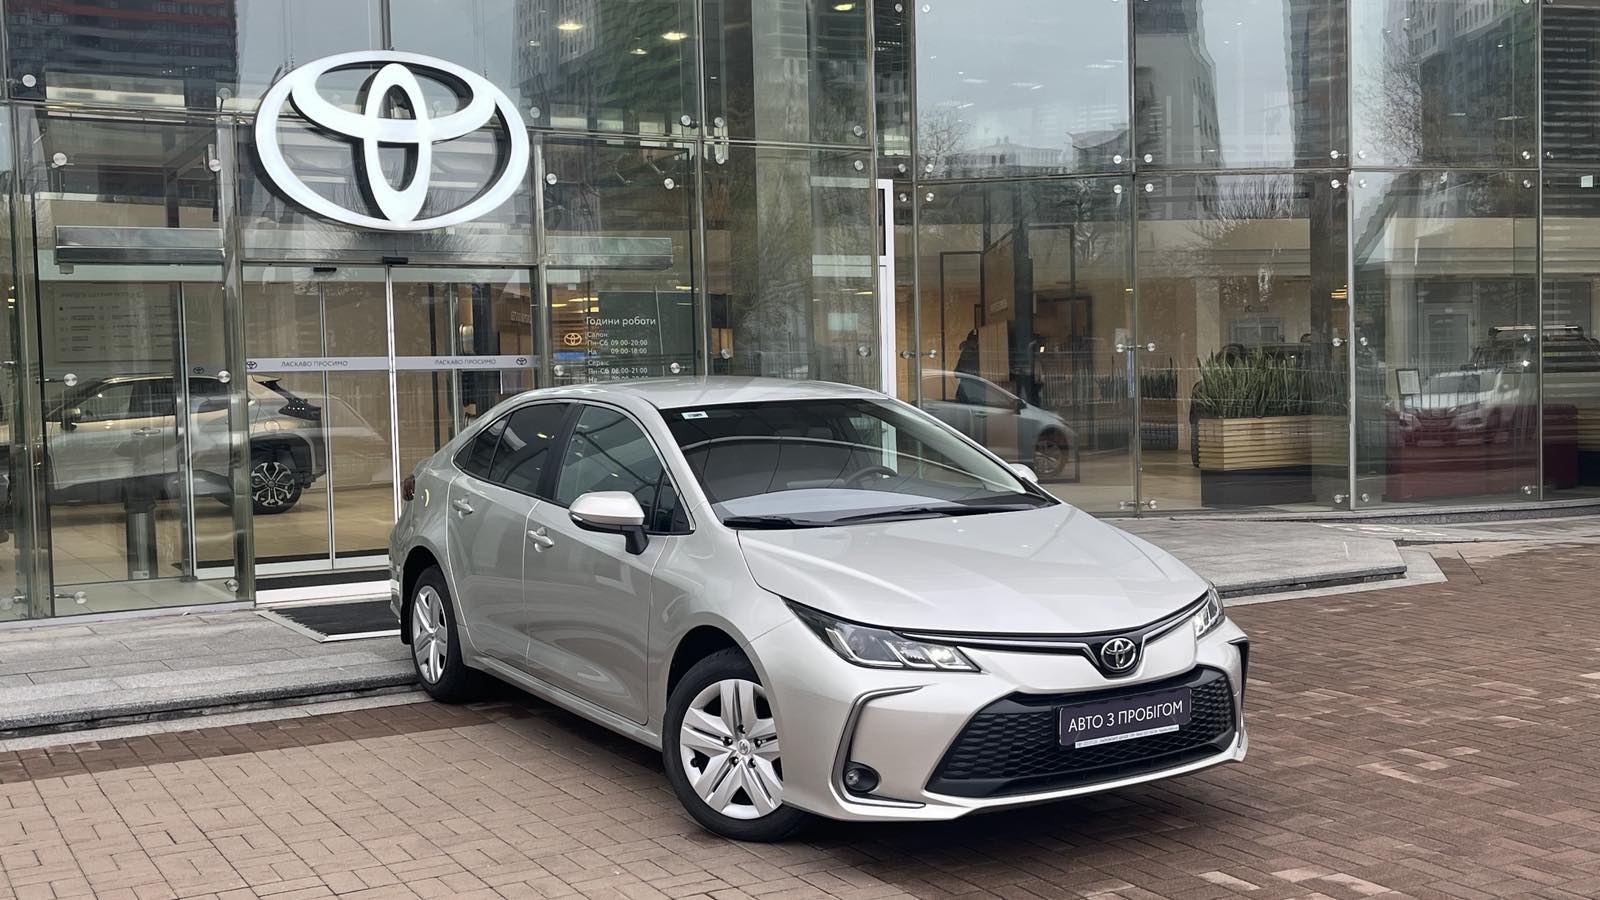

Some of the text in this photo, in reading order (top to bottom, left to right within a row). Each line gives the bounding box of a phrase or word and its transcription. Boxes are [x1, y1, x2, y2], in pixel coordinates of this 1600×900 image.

[586, 316, 656, 327] Години роботи
[1068, 715, 1103, 732] АВТО
[1118, 700, 1183, 725] ПРОБІГОМ
